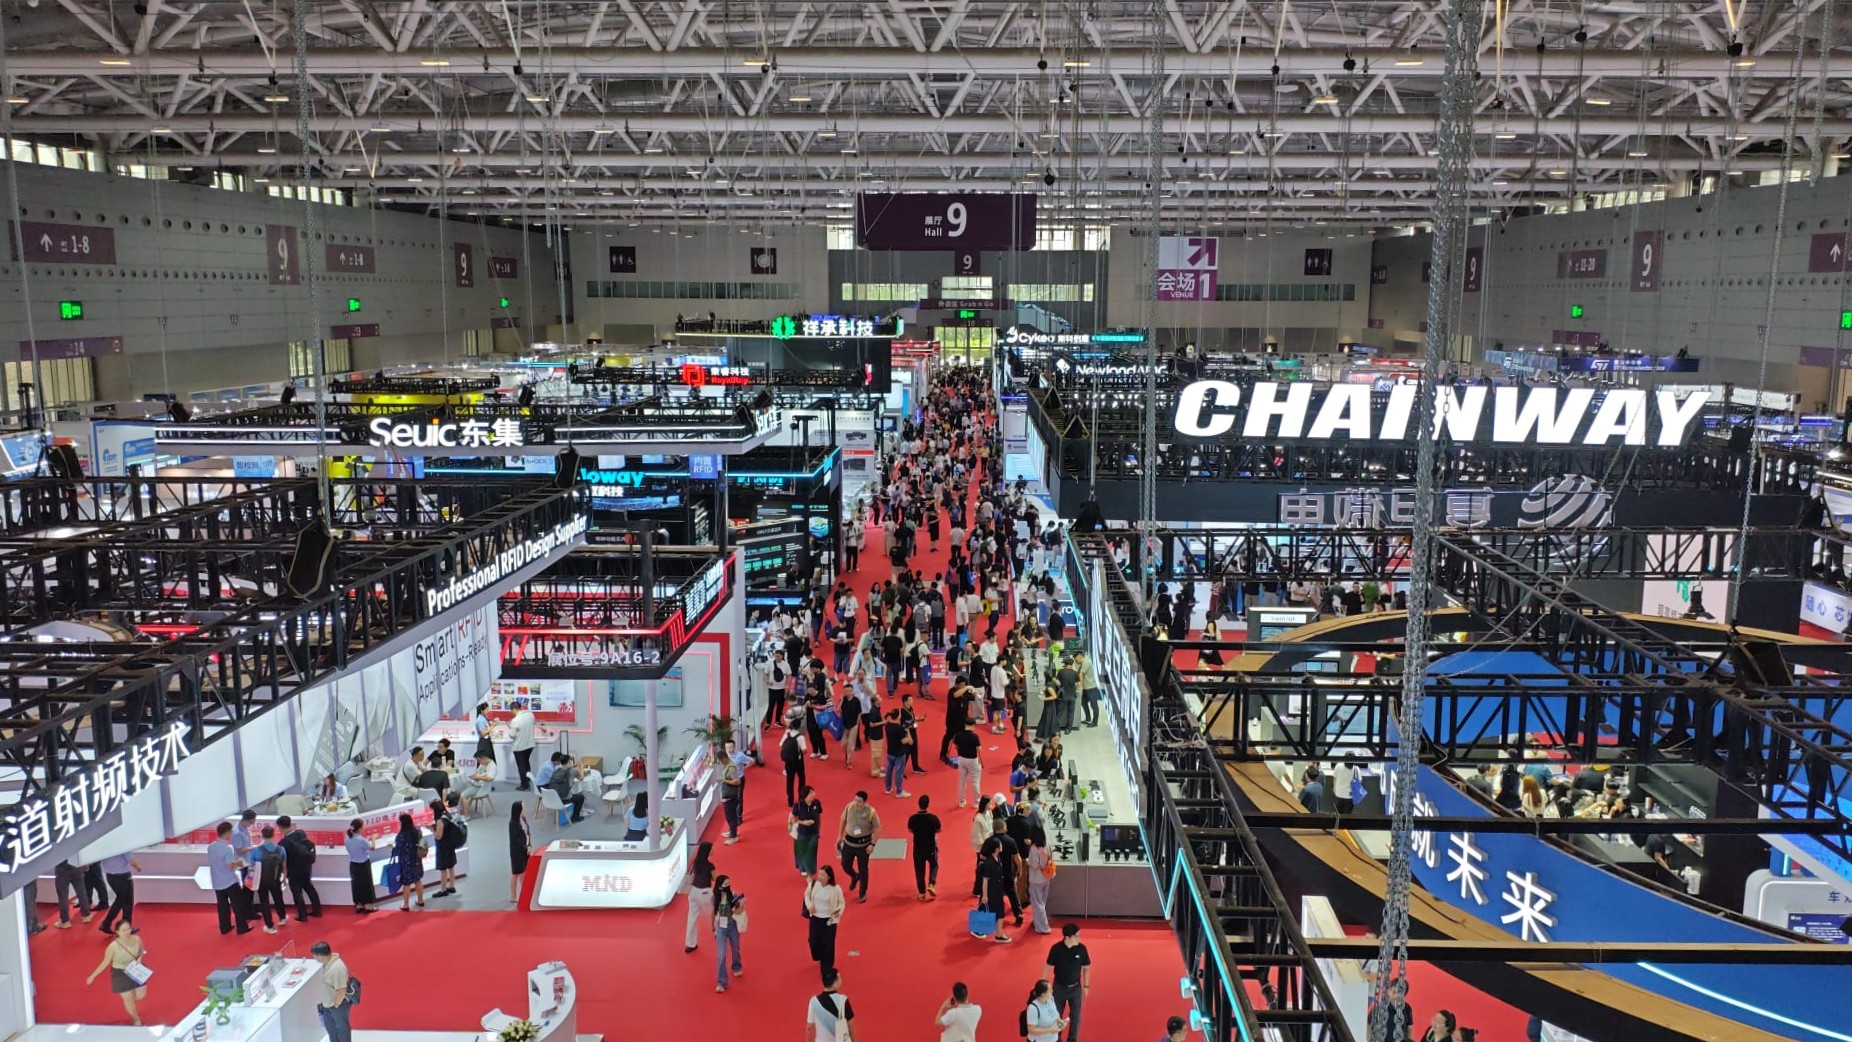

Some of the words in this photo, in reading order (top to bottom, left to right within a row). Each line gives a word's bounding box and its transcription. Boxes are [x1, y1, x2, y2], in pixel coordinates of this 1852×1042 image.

[925, 216, 942, 225] 展厅
[947, 202, 967, 237] 9
[925, 228, 942, 236] Hall
[72, 236, 90, 253] 1-8
[279, 239, 289, 270] 9
[461, 253, 467, 276] 9
[963, 255, 972, 270] 9
[1470, 257, 1476, 281] 9
[1642, 244, 1652, 276] 9
[1157, 272, 1195, 291] 会场
[1200, 273, 1209, 298] 1
[803, 319, 873, 336] 祥承科技
[1019, 333, 1055, 345] Cykeo
[1174, 380, 1711, 446] CHAINWAY
[369, 417, 457, 447] Seuic
[459, 419, 523, 447] 东集
[693, 465, 713, 473] RFID
[427, 556, 500, 617] Professional
[501, 545, 525, 576] RFID
[525, 533, 555, 562] Design
[556, 513, 587, 546] Supplier
[415, 627, 455, 674] Smart
[456, 607, 483, 642] RFID
[547, 651, 660, 667] 展位号:9A16-2
[0, 721, 191, 874] 道射频技术
